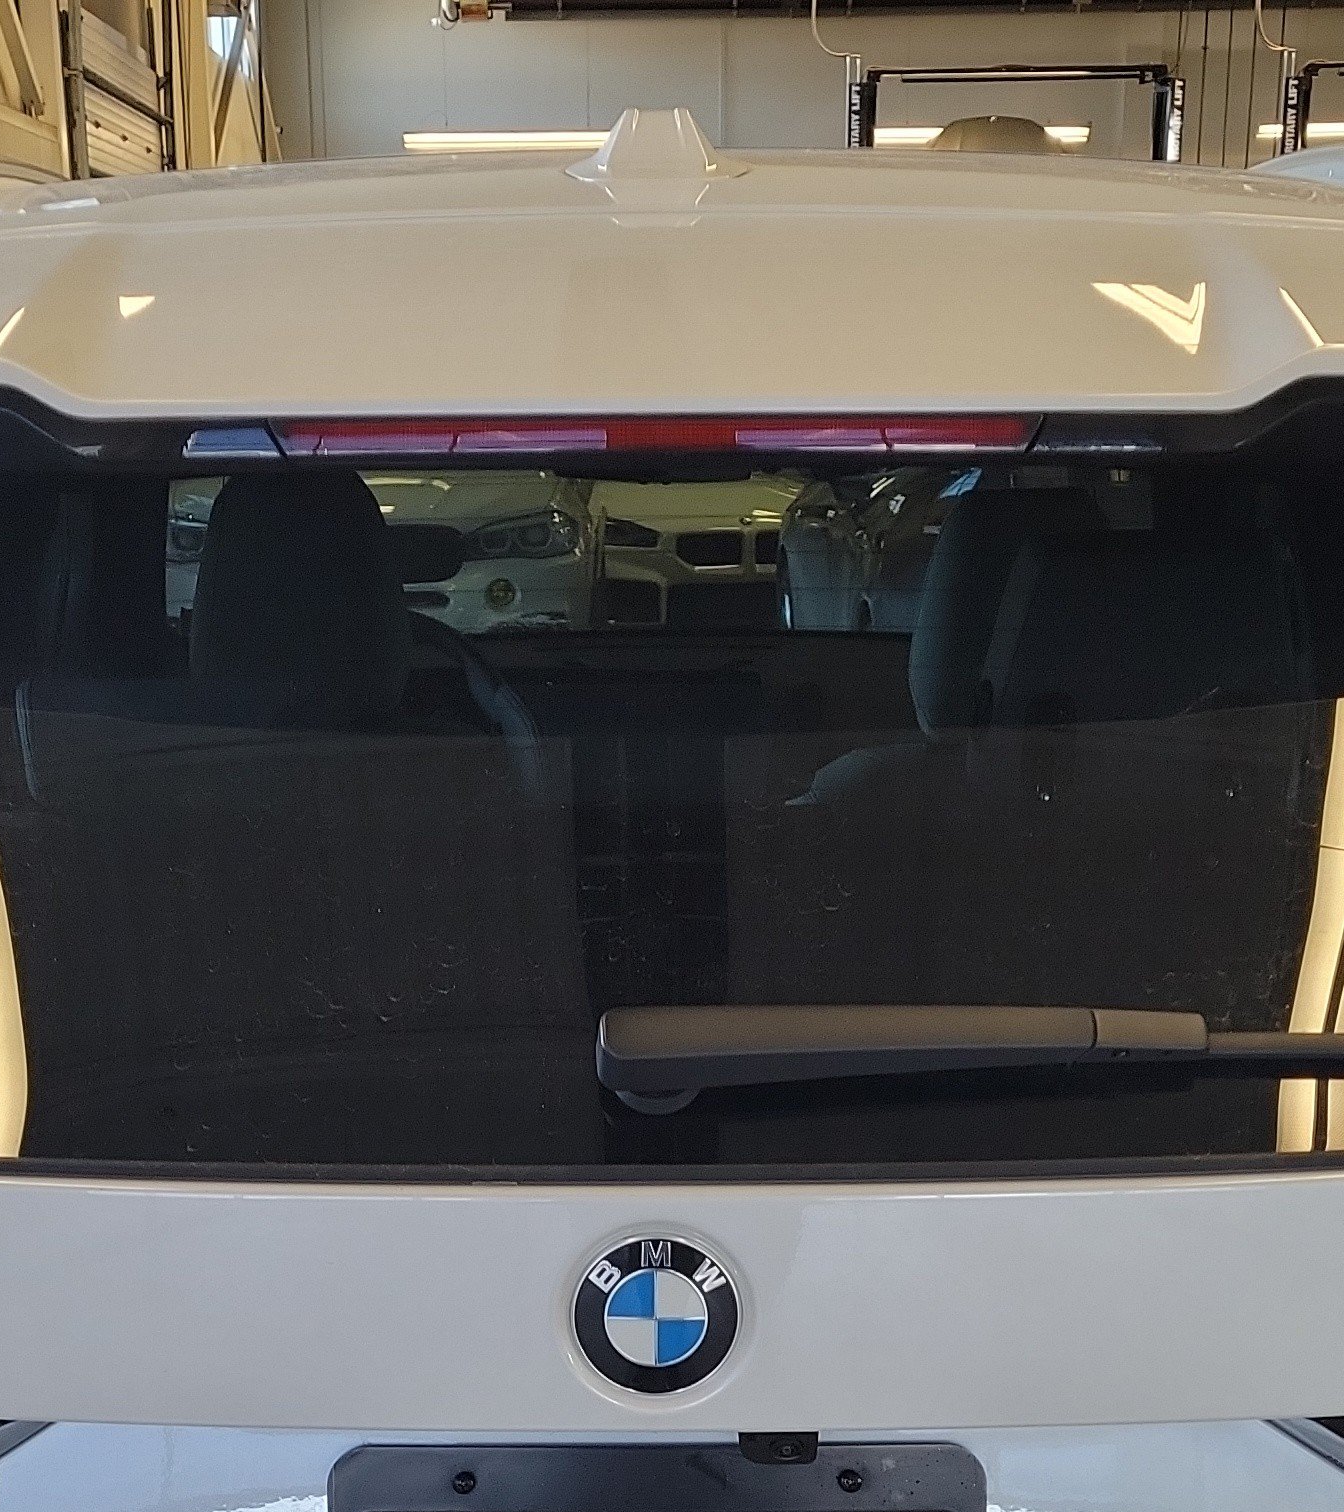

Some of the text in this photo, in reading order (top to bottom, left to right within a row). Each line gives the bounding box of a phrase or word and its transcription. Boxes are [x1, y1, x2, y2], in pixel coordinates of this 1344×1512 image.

[850, 85, 861, 111] LIFT
[1173, 79, 1185, 106] LIFT
[1287, 79, 1299, 105] LIFT
[588, 1240, 727, 1294] BMW
